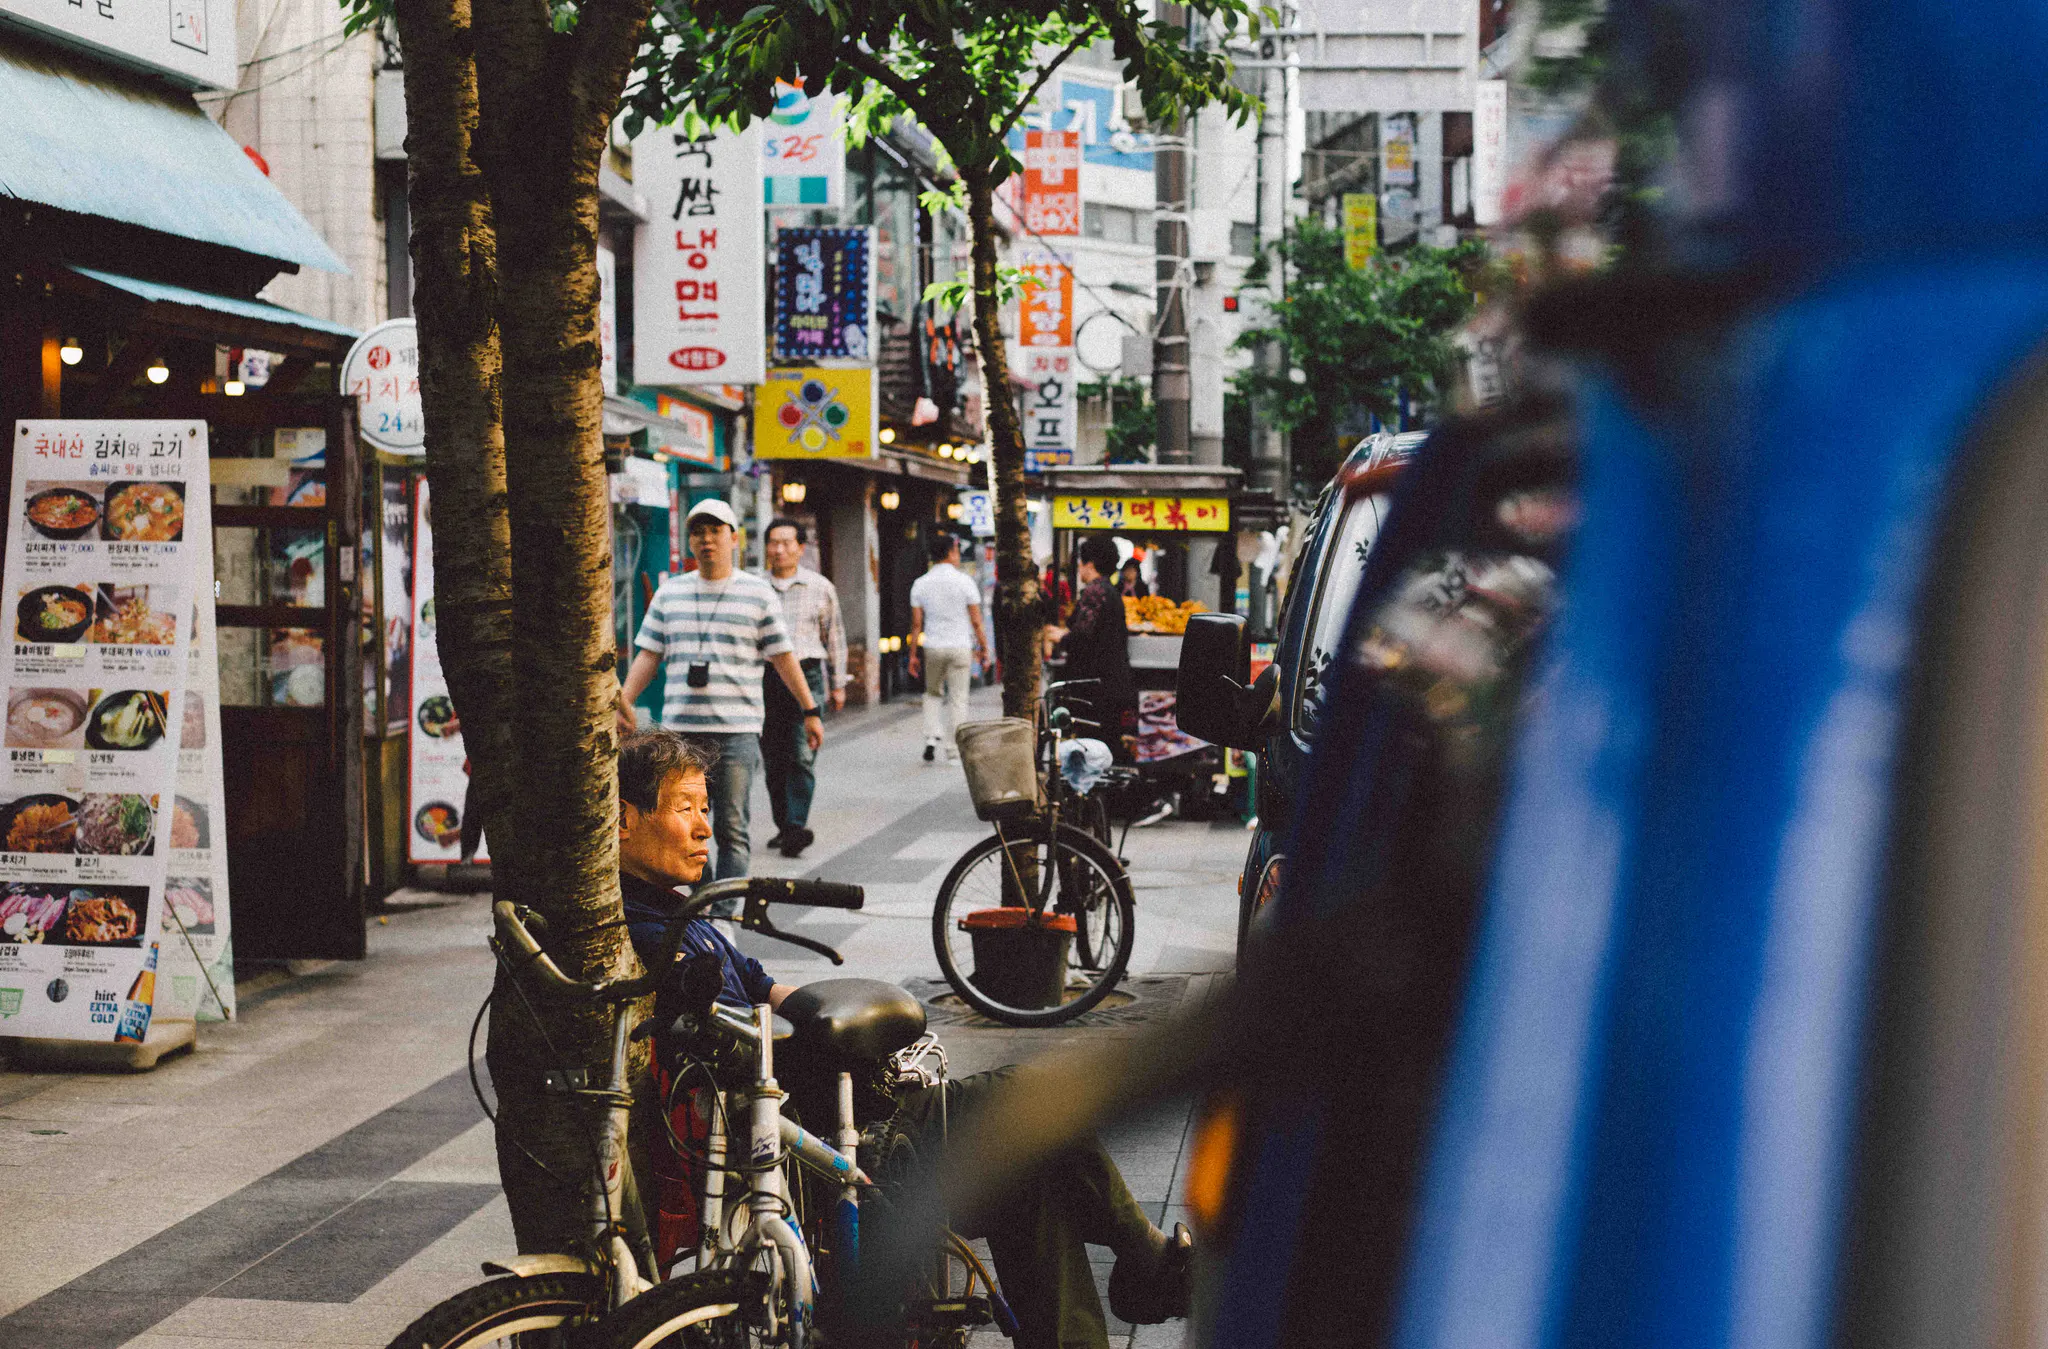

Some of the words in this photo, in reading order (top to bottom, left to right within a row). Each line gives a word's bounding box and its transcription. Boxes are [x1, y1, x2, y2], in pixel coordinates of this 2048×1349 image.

[34, 437, 84, 459] 국내산
[94, 438, 140, 459] 김치와
[149, 439, 182, 459] 고기
[90, 1002, 118, 1013] EXTRA
[91, 1013, 115, 1024] COLD
